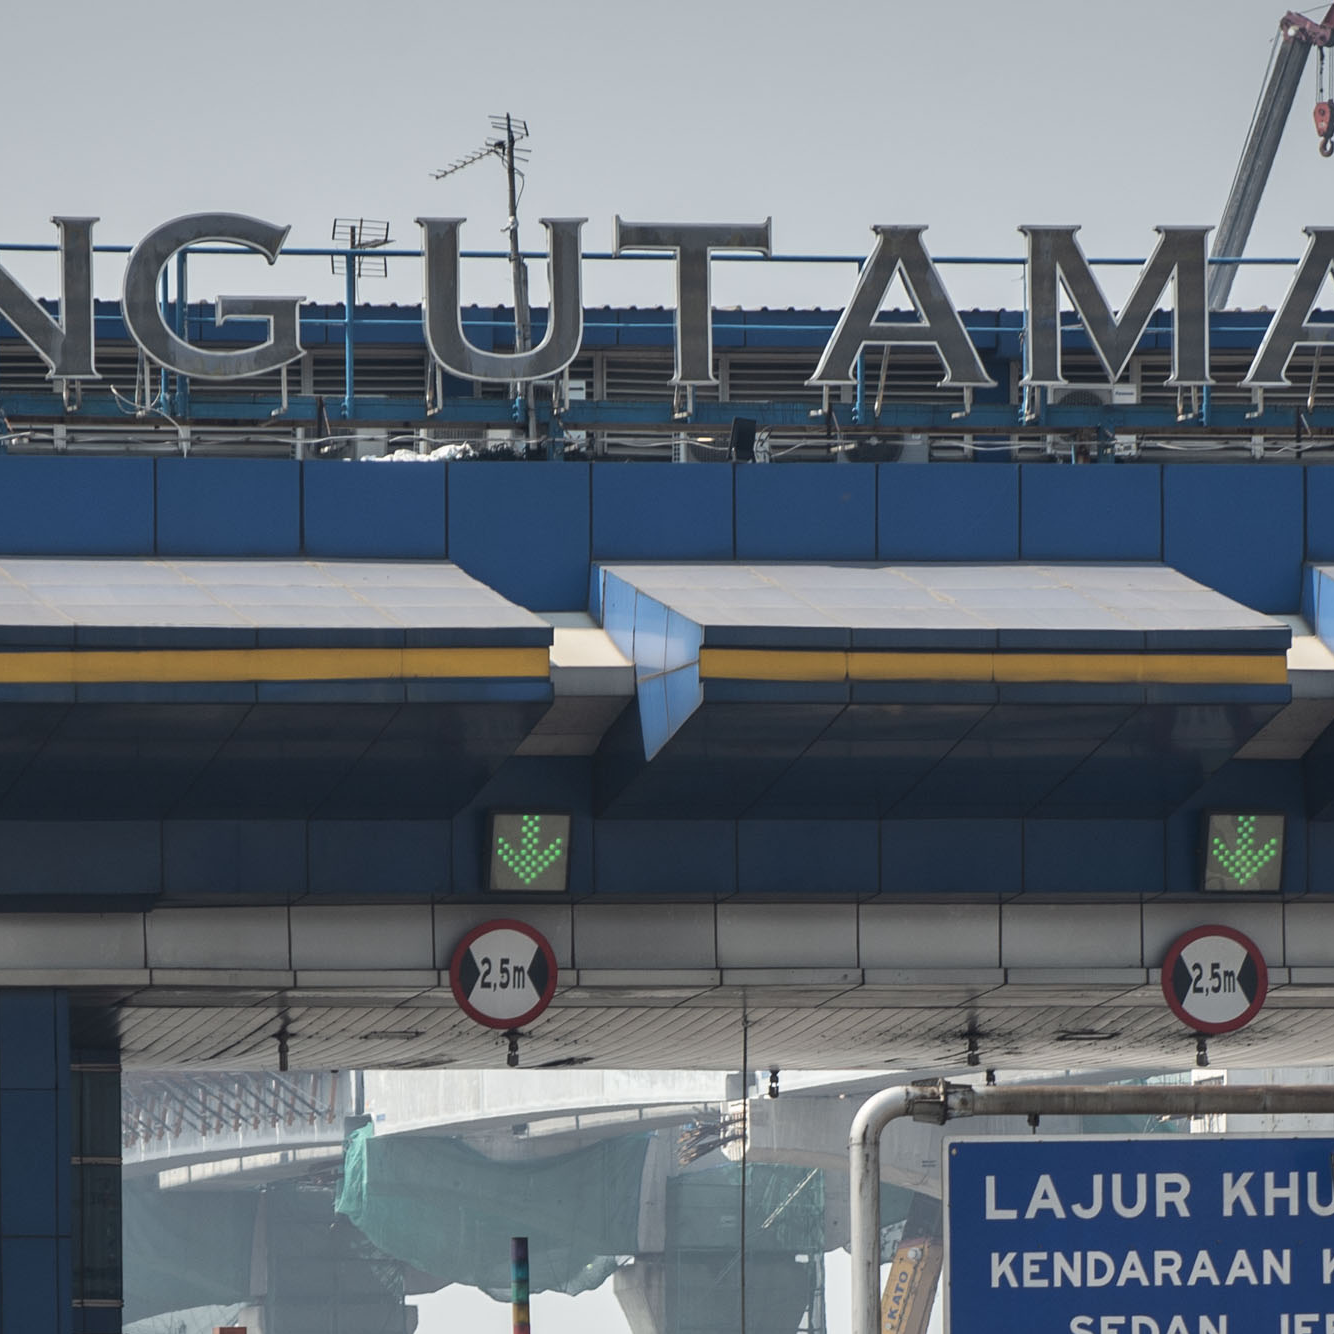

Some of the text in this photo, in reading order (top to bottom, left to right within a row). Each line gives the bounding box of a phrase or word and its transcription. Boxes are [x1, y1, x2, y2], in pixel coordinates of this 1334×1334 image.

[984, 1172, 1191, 1220] LAJUR
[990, 1249, 1292, 1288] KENDARAAN
[887, 1271, 909, 1320] KATO
